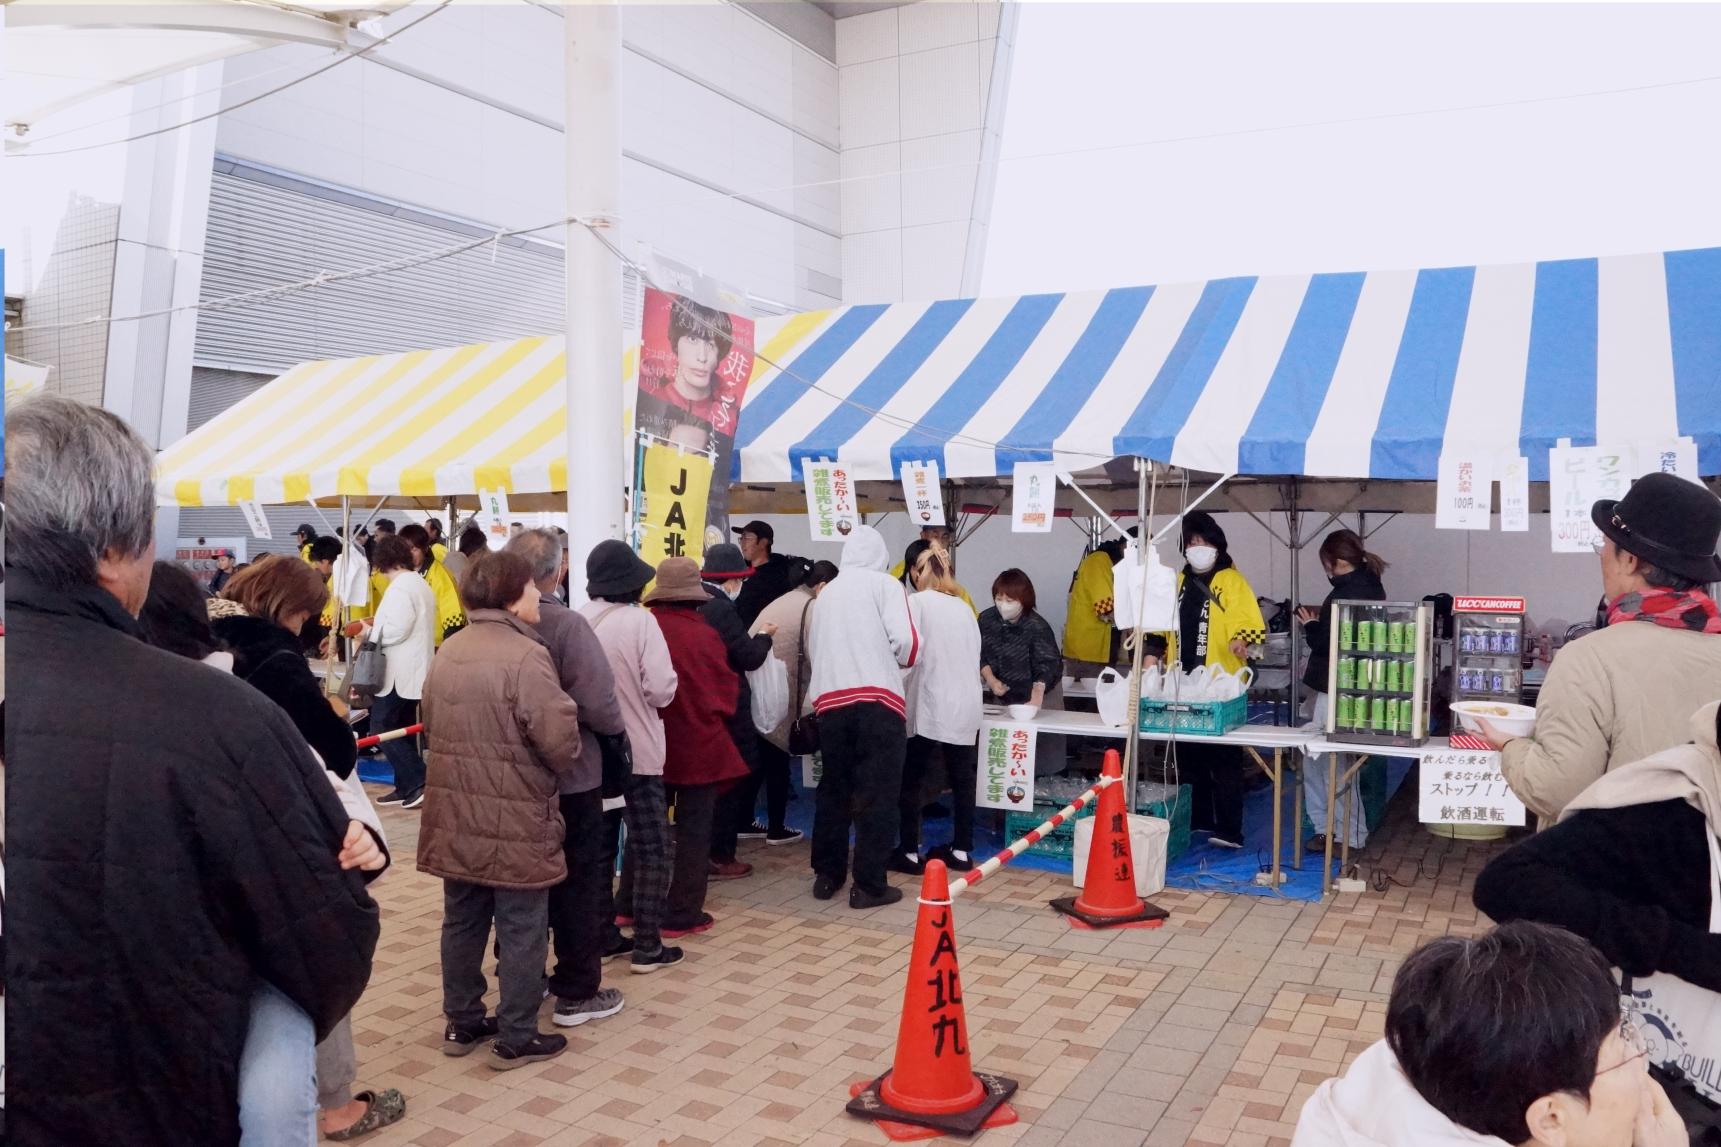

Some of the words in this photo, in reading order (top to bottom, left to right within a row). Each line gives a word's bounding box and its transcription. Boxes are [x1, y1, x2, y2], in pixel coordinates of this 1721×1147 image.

[1565, 457, 1588, 506] ビール
[1440, 805, 1505, 821] 飲酒運転
